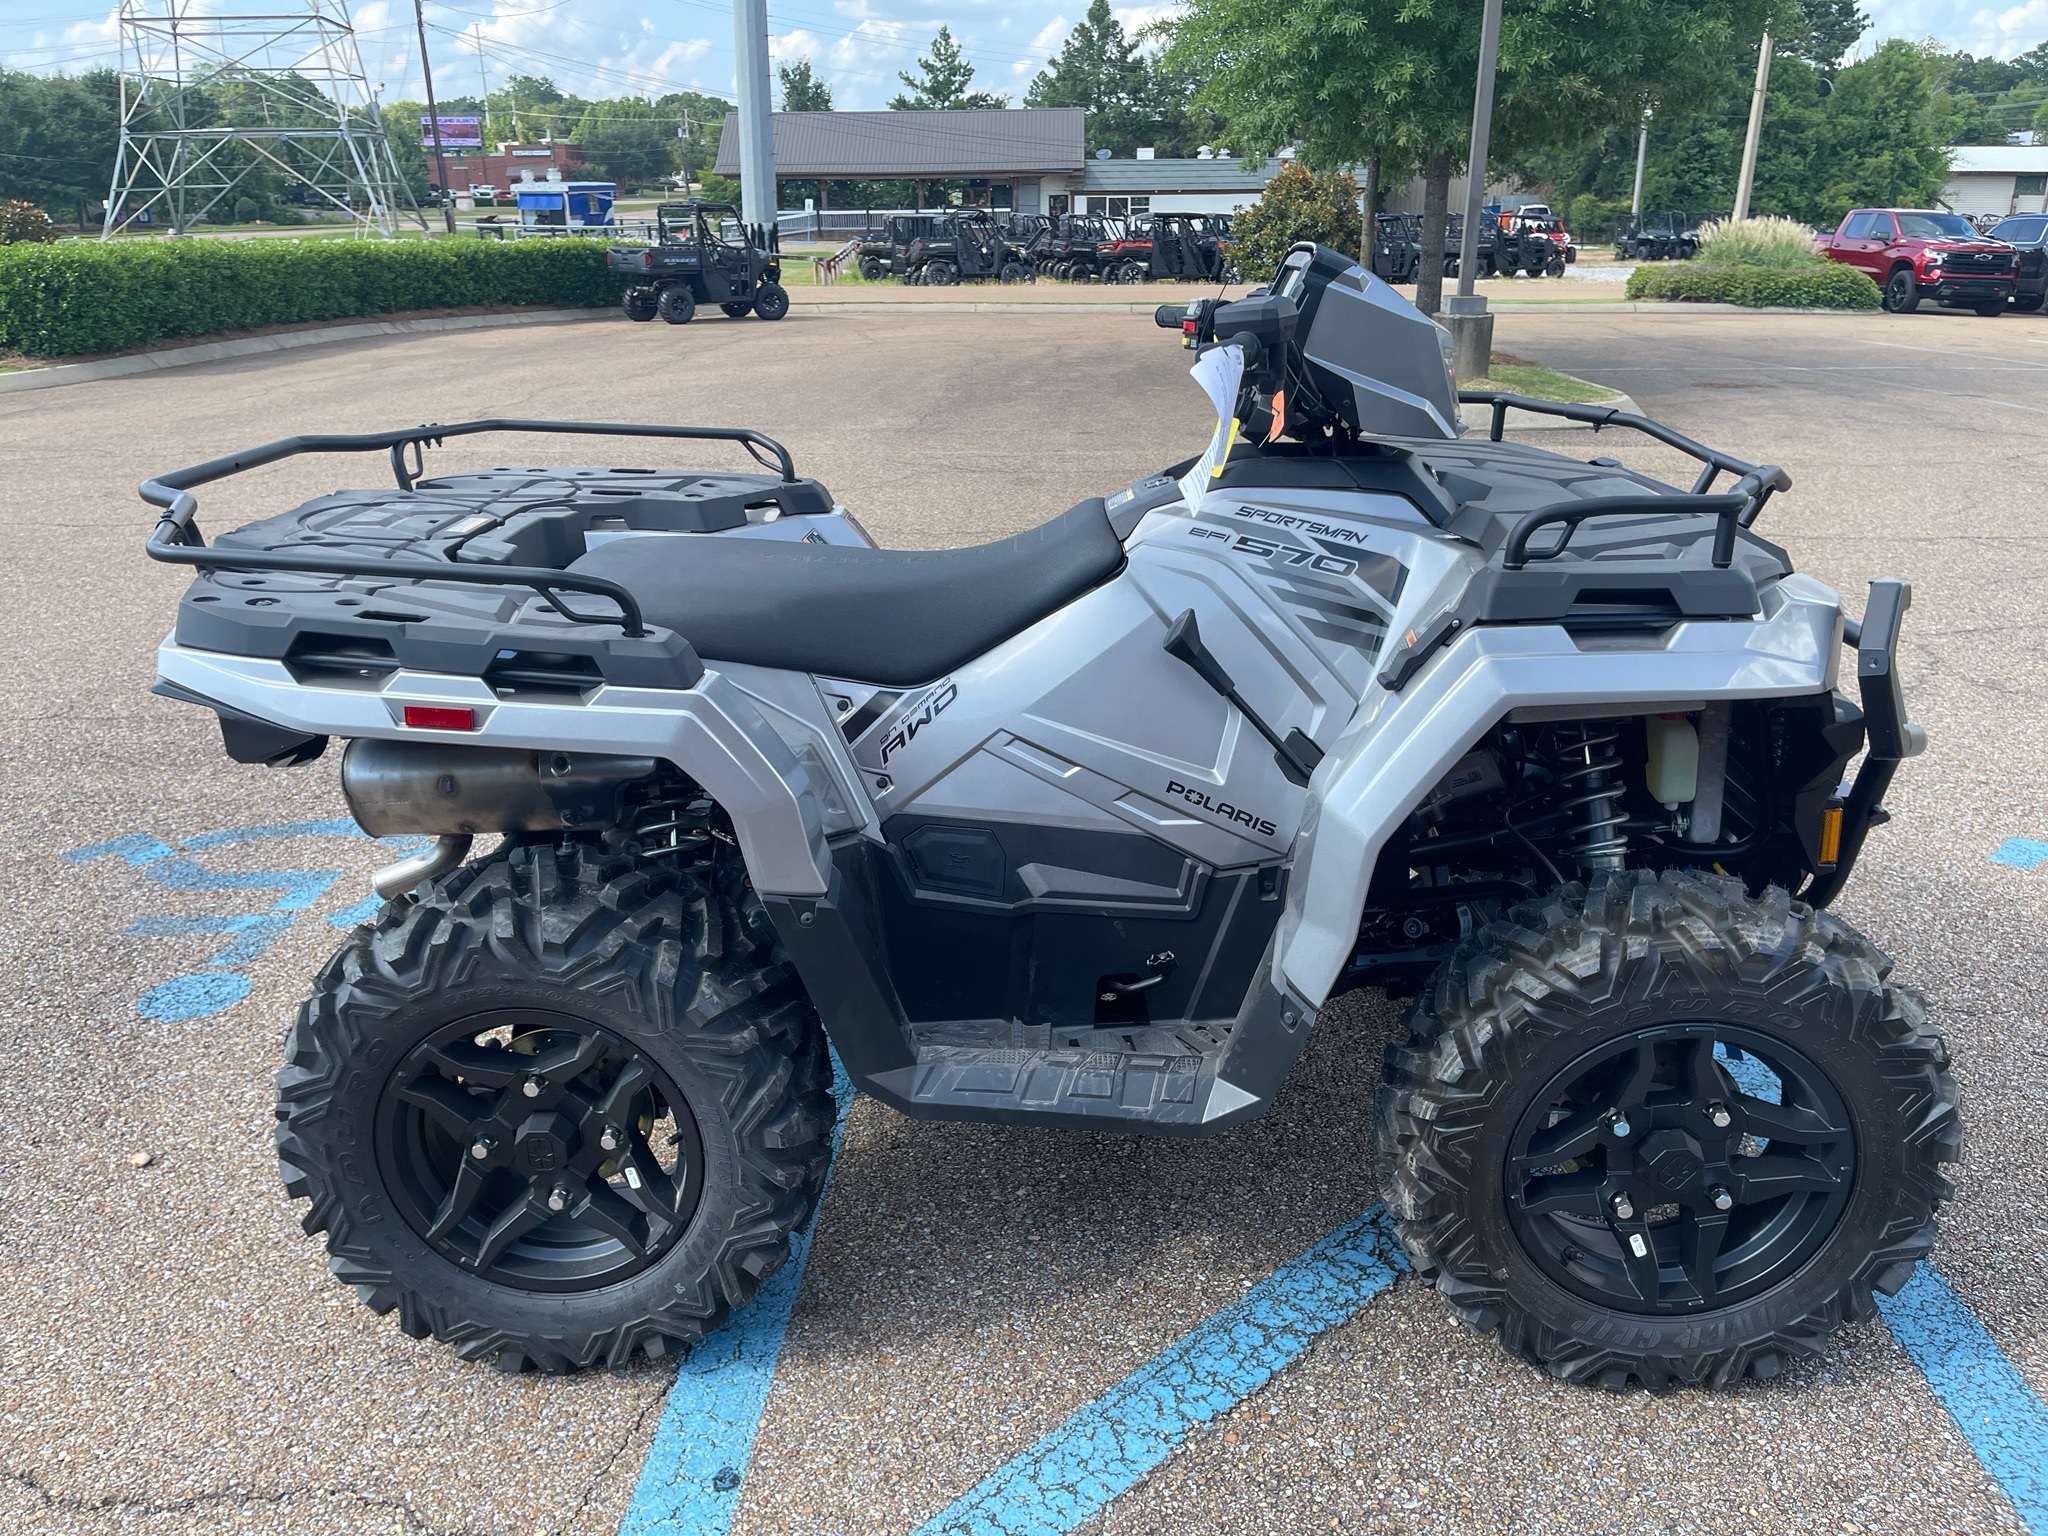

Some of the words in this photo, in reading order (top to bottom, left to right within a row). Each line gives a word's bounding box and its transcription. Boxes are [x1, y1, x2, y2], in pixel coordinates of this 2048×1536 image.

[1235, 505, 1369, 544] SPORTSMAN
[1188, 527, 1232, 543] EFI
[1231, 534, 1360, 579] 570
[880, 726, 897, 744] ON
[901, 677, 951, 725] DEMAND
[881, 683, 958, 765] AWD
[1165, 780, 1277, 837] POLARIS
[1618, 998, 1803, 1030] DURO
[1569, 1314, 1662, 1349] GRIP
[1673, 1289, 1803, 1349] POWER
